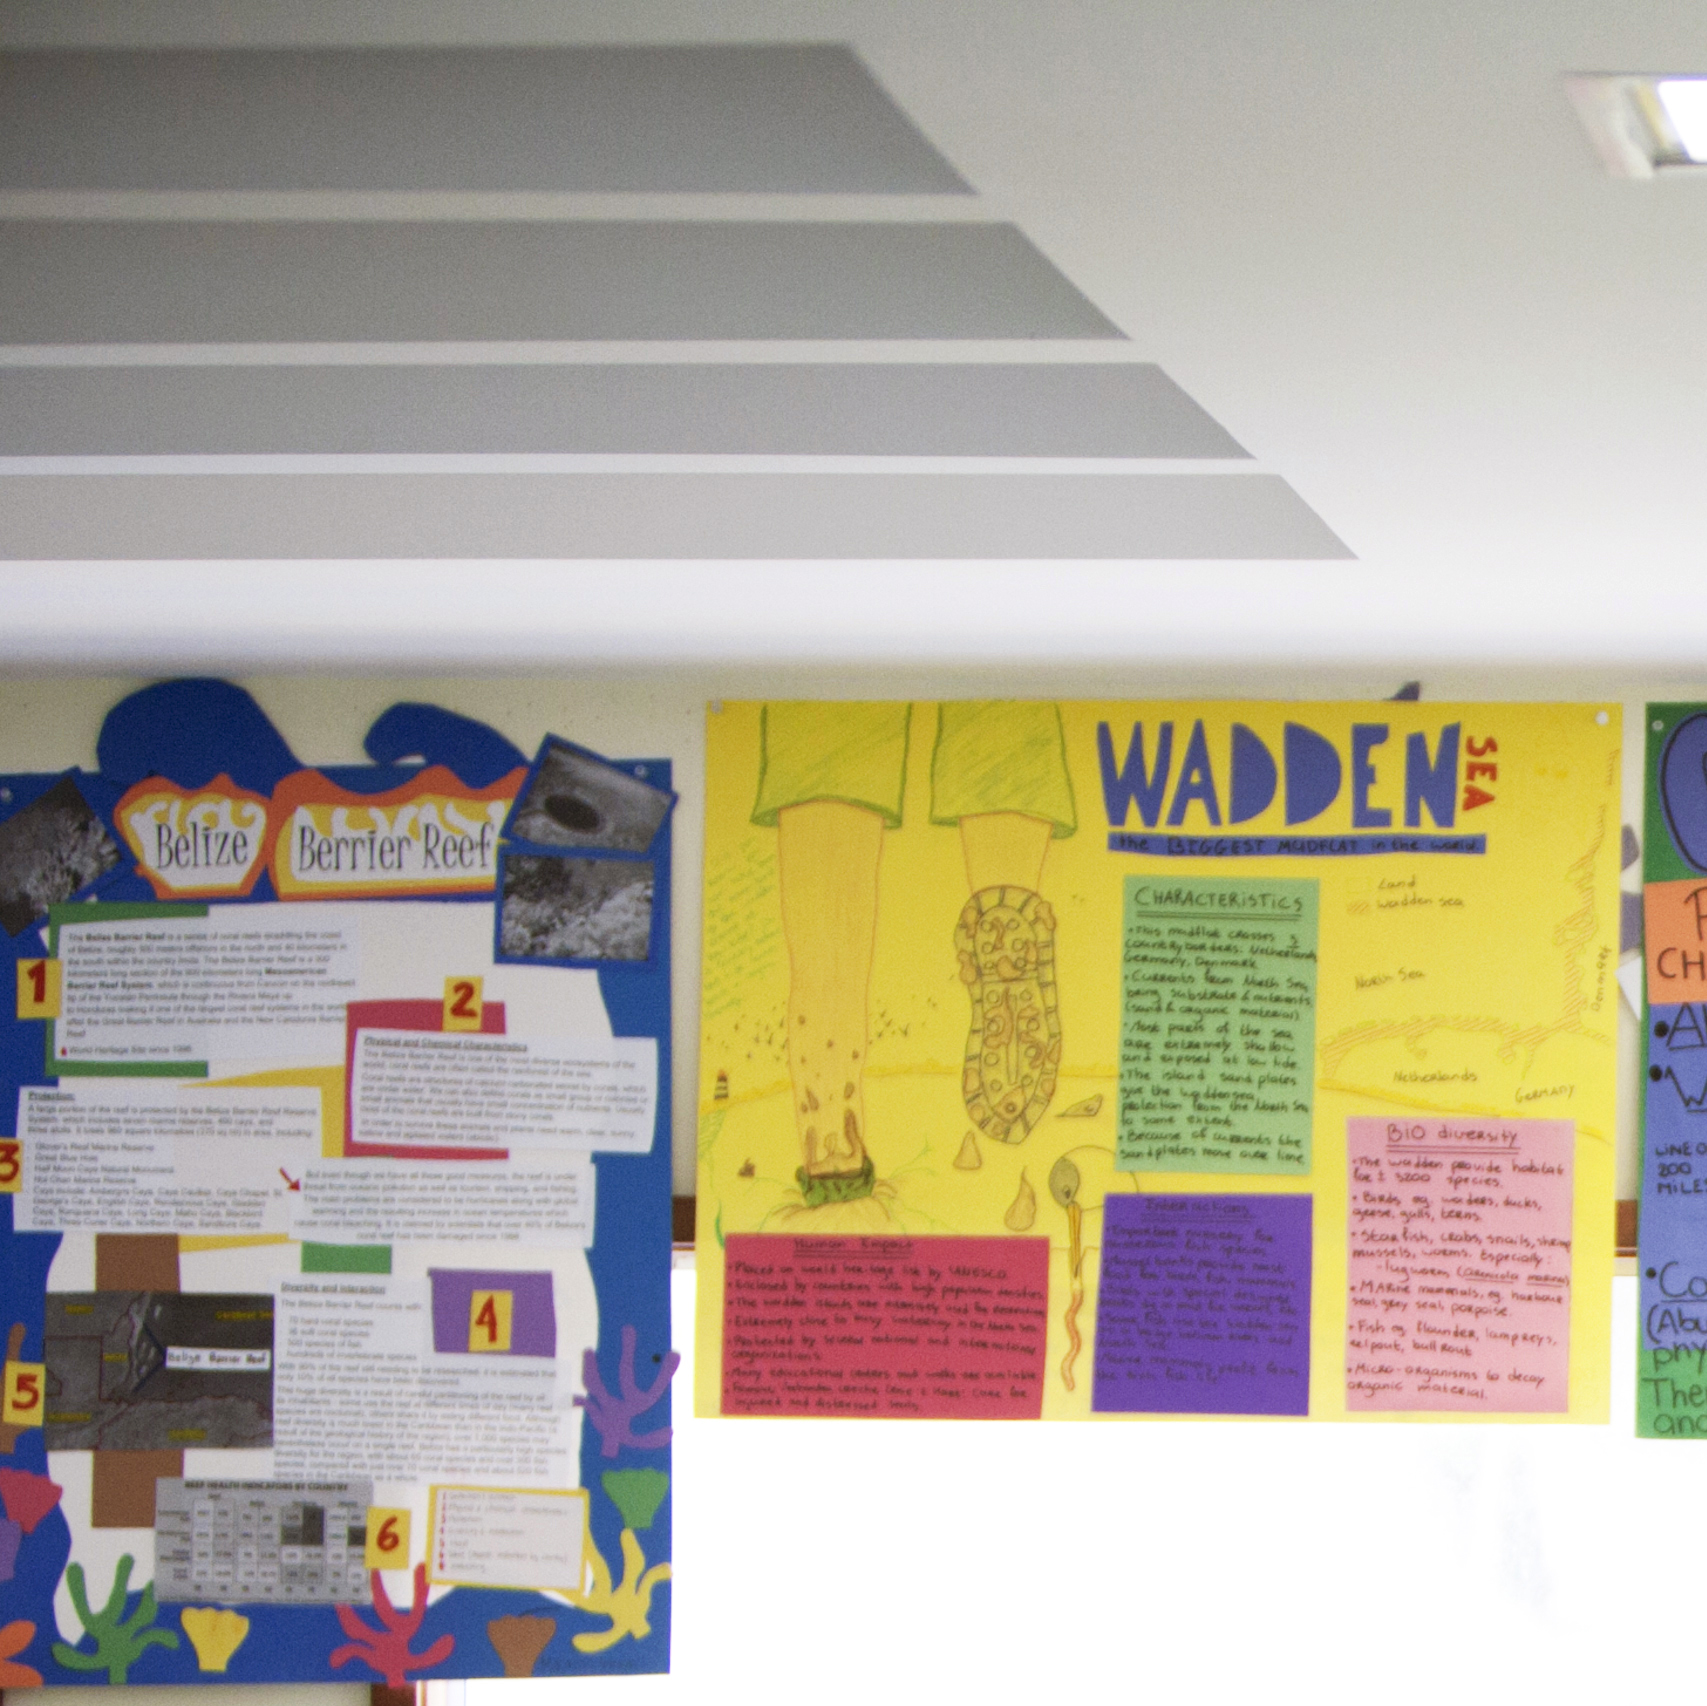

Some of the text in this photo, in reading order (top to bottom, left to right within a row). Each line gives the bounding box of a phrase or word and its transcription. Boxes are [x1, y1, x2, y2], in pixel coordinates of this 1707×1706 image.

[1096, 719, 1461, 827] WADDEN
[1462, 735, 1498, 811] SEA
[155, 822, 495, 871] Belize Berrier Reef
[1119, 836, 1148, 849] the
[1167, 838, 1264, 857] BIGGEST
[1372, 842, 1385, 850] in
[1392, 838, 1418, 851] the
[1430, 841, 1476, 851] world
[26, 960, 46, 1003] 1
[448, 982, 477, 1018] 2
[1355, 969, 1425, 991] North Sea
[0, 1142, 19, 1183] 3
[475, 1295, 498, 1343] 4
[12, 1374, 39, 1410] 5
[376, 1516, 400, 1551] 6
